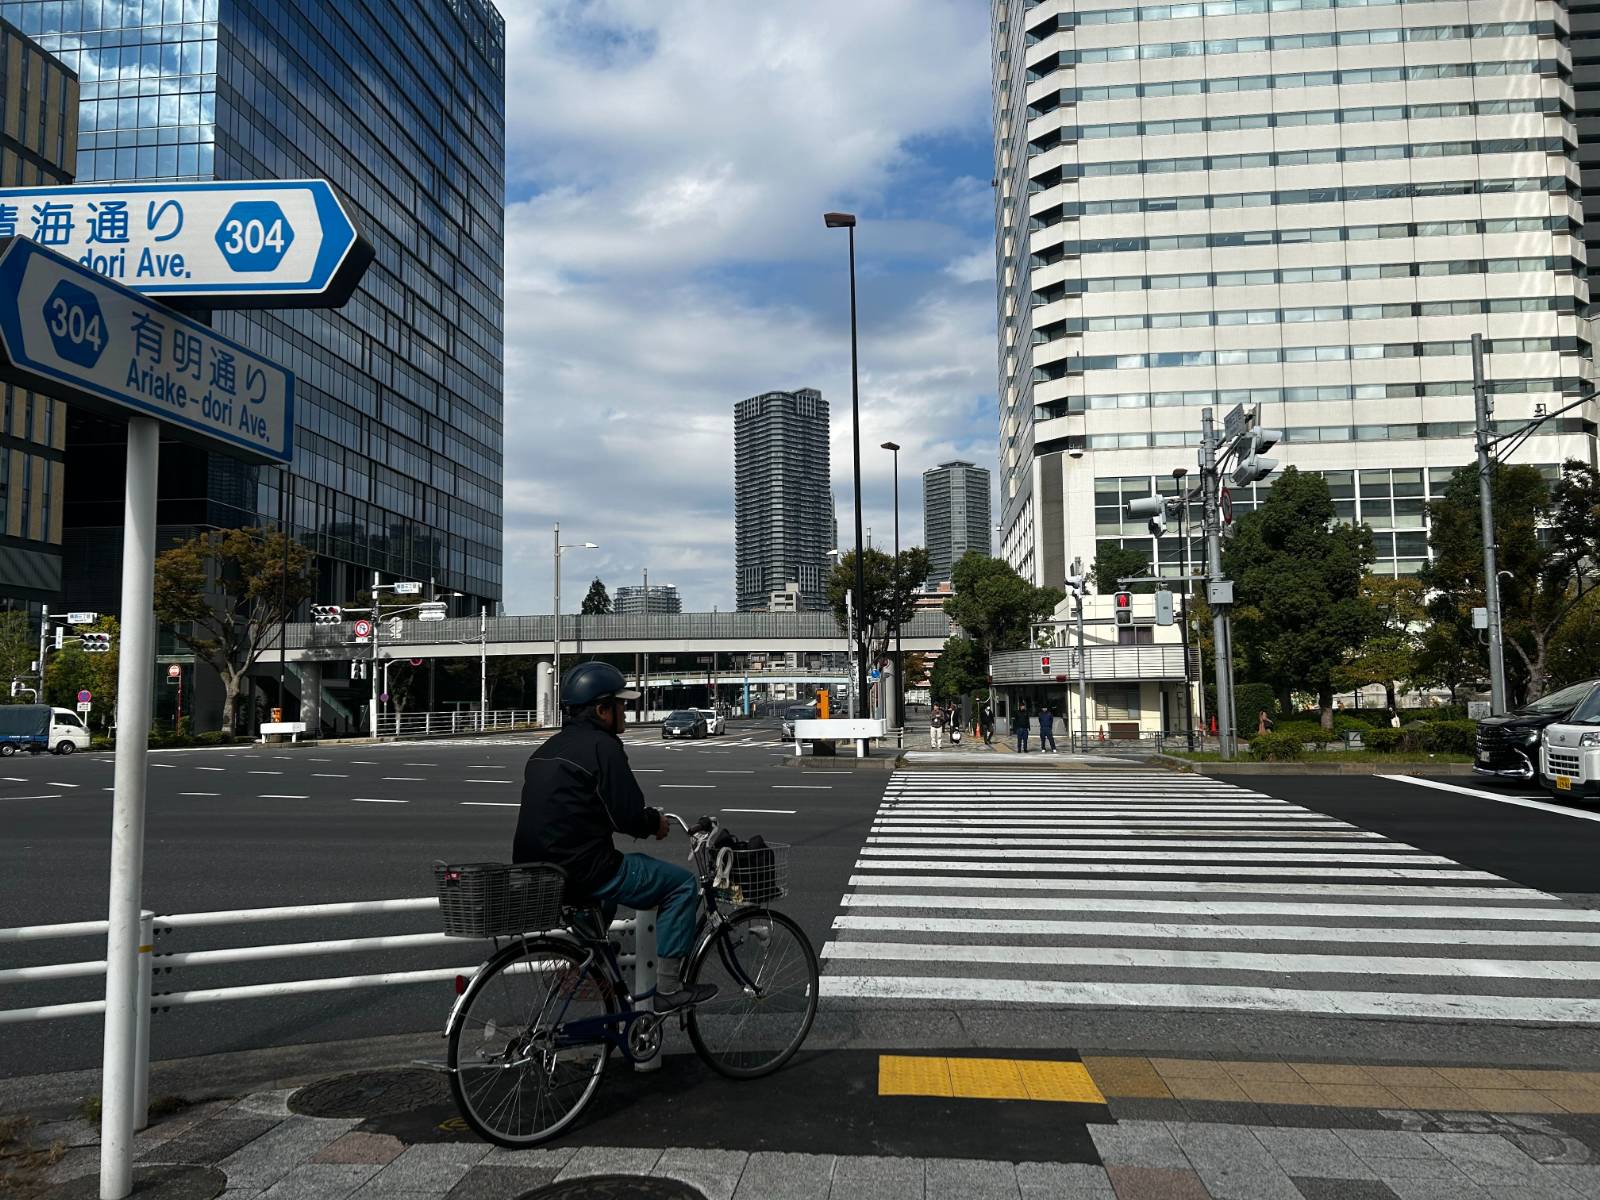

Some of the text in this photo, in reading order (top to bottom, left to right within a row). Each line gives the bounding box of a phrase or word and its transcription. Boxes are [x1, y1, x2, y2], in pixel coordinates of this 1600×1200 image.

[224, 218, 285, 254] 304
[136, 247, 191, 278] Ave.
[51, 297, 101, 352] 304
[131, 310, 267, 404] 有明通り
[239, 404, 270, 442] Ave.
